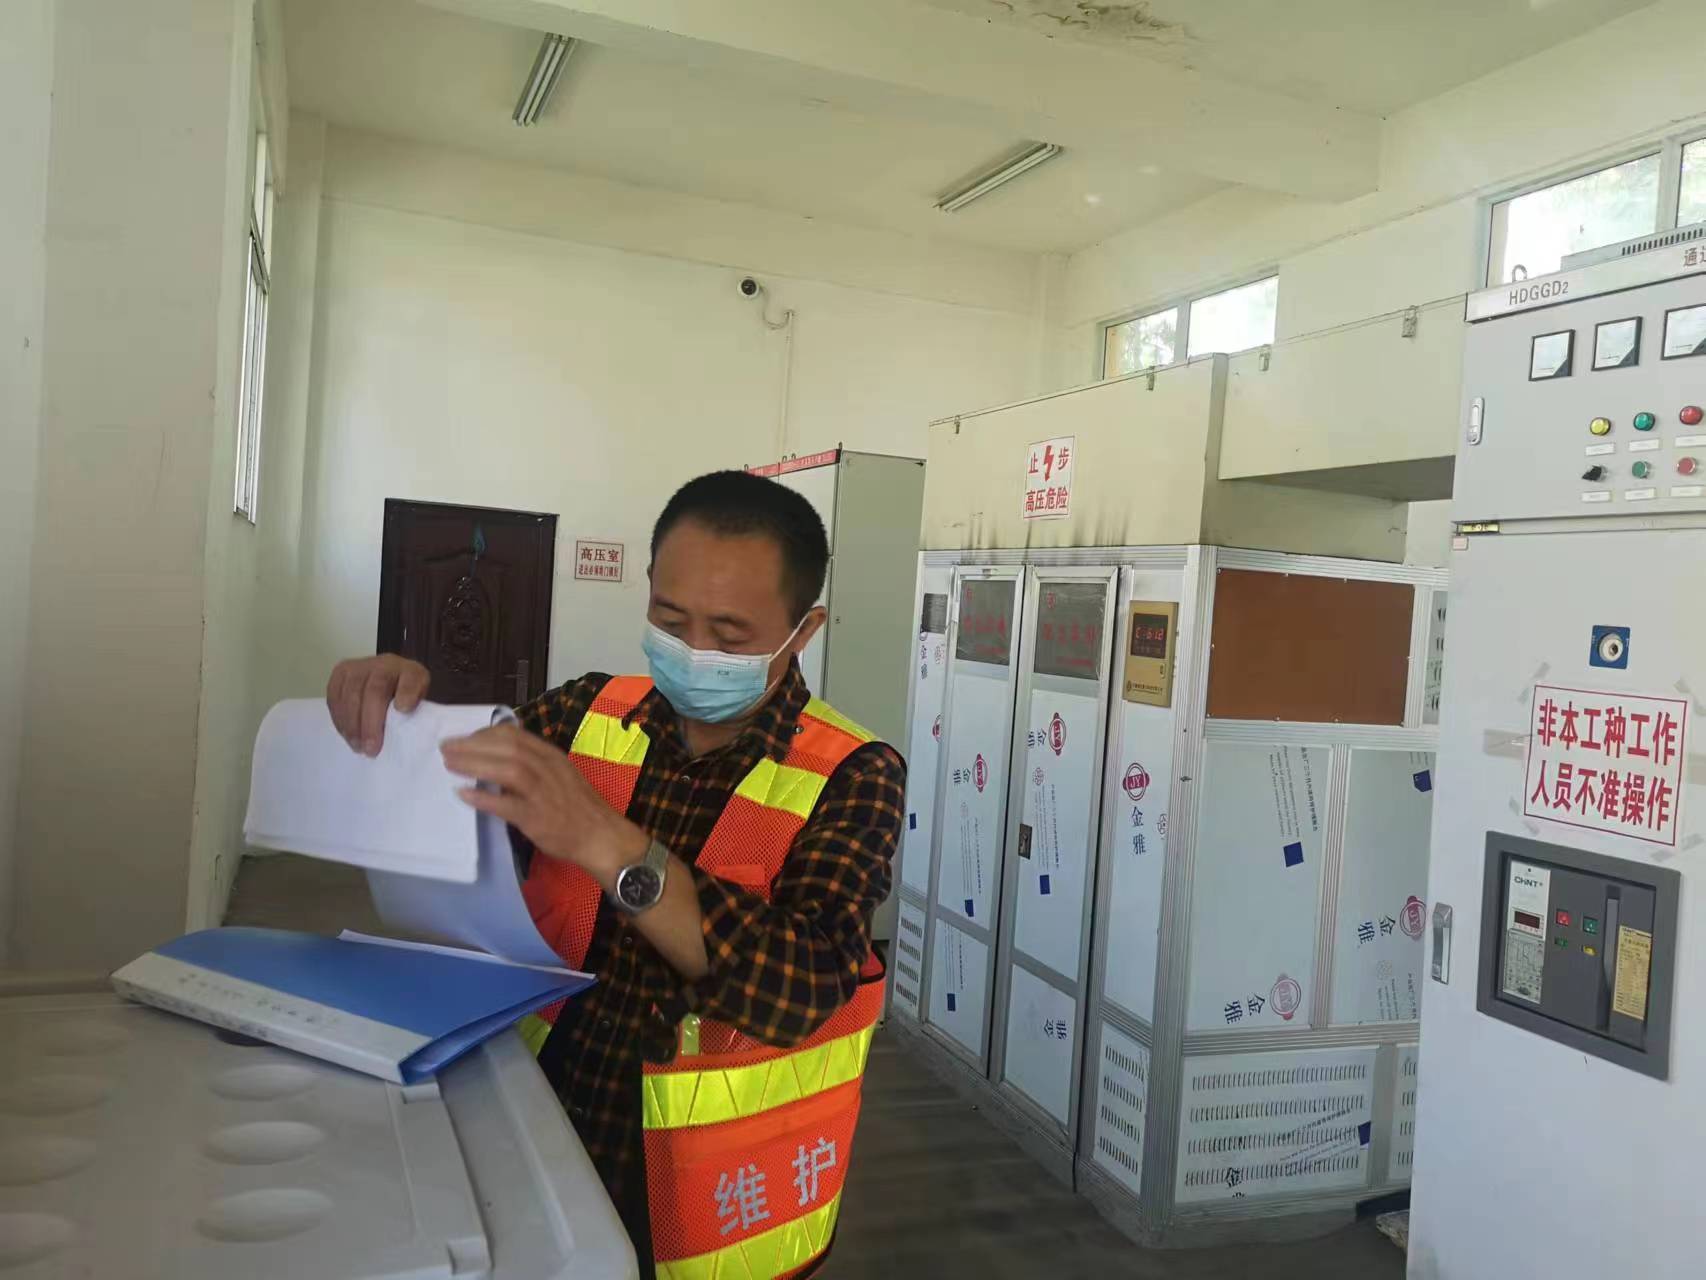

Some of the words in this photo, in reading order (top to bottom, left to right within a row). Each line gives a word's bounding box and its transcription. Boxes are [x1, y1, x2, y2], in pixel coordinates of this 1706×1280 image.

[1509, 280, 1569, 305] HDGGD2
[1026, 486, 1068, 512] 高压危险
[581, 547, 619, 562] 高压室
[1537, 698, 1677, 766] 非本工种工作
[1531, 760, 1672, 831] 人员不准操作
[714, 1137, 836, 1235] 维护
